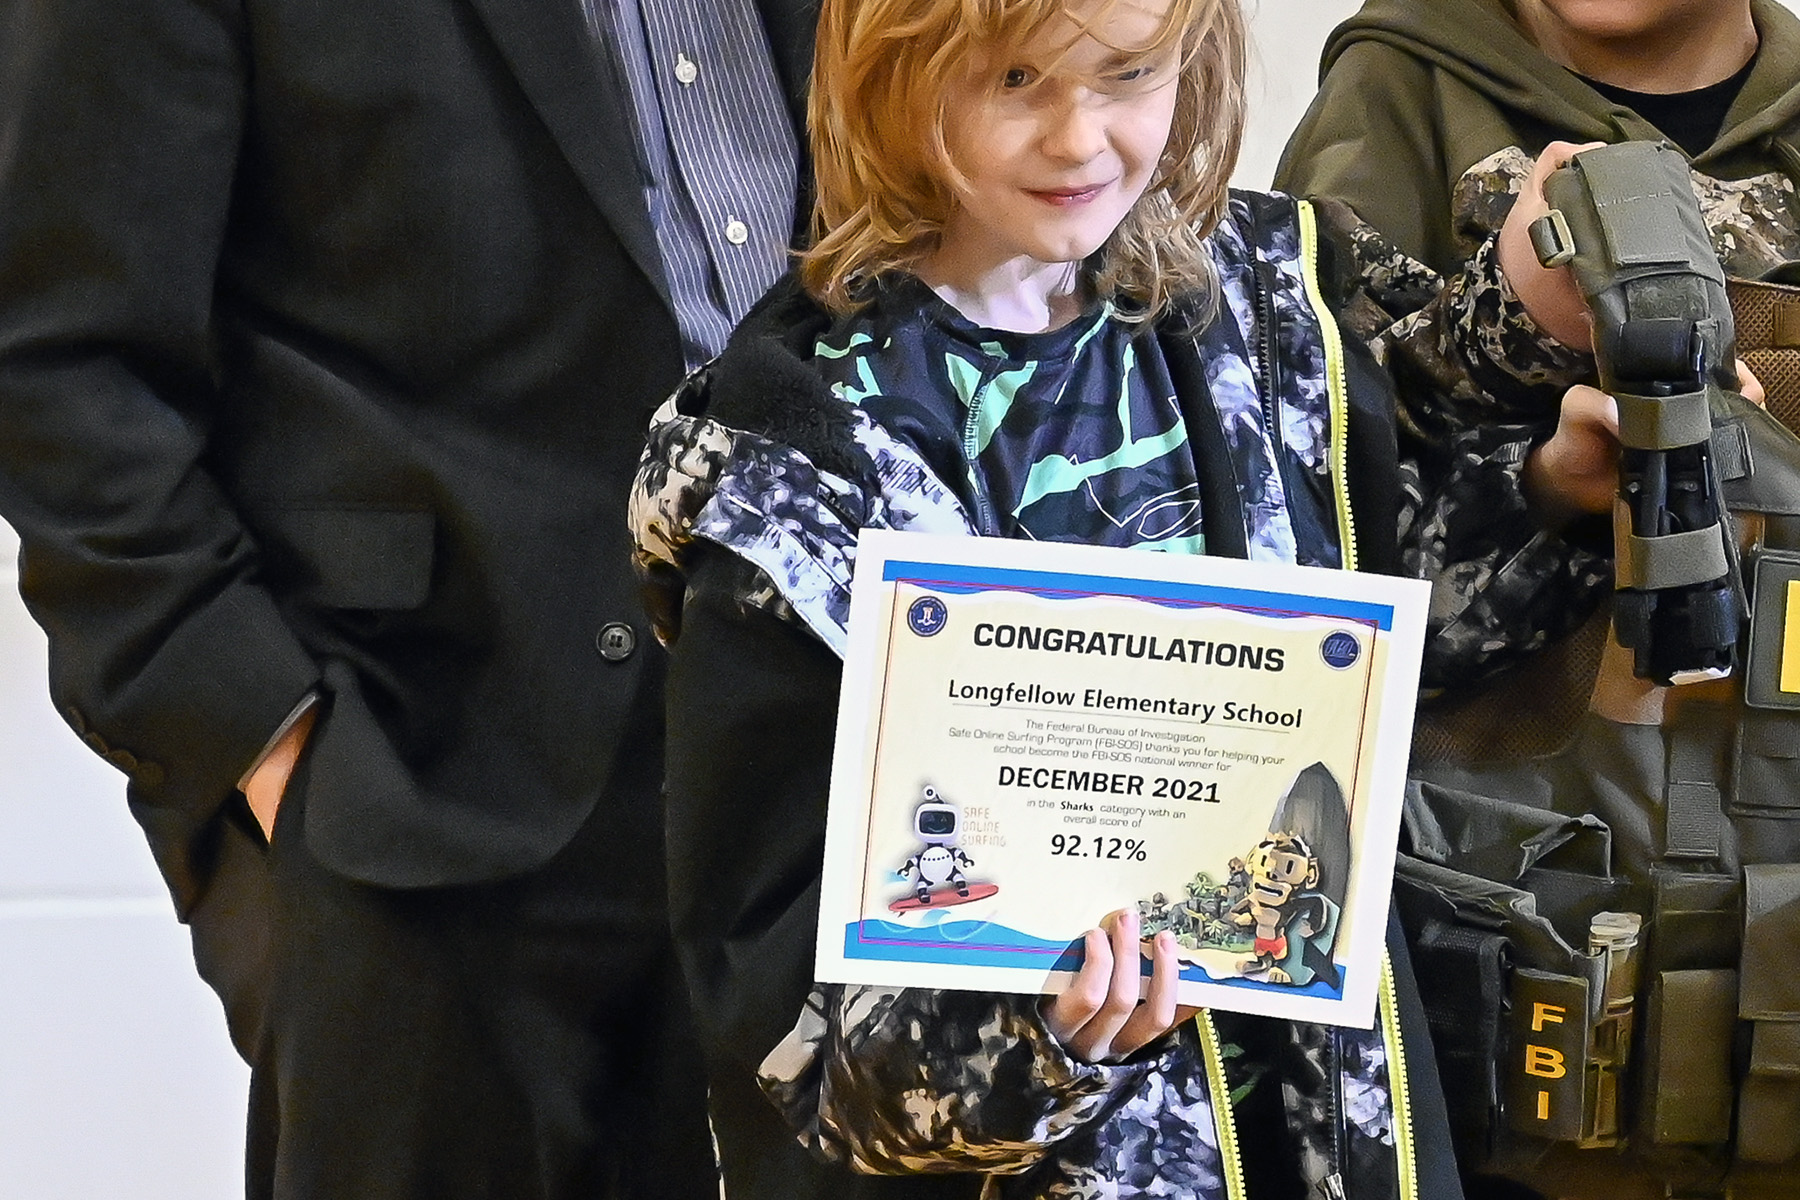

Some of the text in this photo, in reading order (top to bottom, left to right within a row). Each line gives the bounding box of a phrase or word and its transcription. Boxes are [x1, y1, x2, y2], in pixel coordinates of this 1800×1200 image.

[973, 623, 1286, 672] CONGRATULATIONS
[949, 680, 1302, 728] Longfellow Elementary School
[1026, 719, 1206, 743] The Federal Bureau of Investigation
[949, 727, 971, 738] Safe
[973, 729, 1005, 740] Online
[1007, 731, 1044, 745] Surfing
[1047, 733, 1092, 747] Program
[1145, 742, 1180, 753] thanks
[1183, 747, 1201, 757] you
[1204, 747, 1219, 758] for
[1221, 749, 1259, 764] helping
[1261, 756, 1285, 765] your
[993, 744, 1231, 771] school become the FBI-SOS national winner for
[998, 765, 1221, 804] DECEMBER 2021
[963, 807, 990, 819] SAFE
[1027, 799, 1186, 819] in the Sharks category with an
[1063, 814, 1142, 828] overall score of
[962, 820, 1000, 833] ONLINE
[961, 835, 1007, 847] SURFING
[1050, 834, 1147, 862] 92.12%
[1525, 1002, 1567, 1120] FBI
